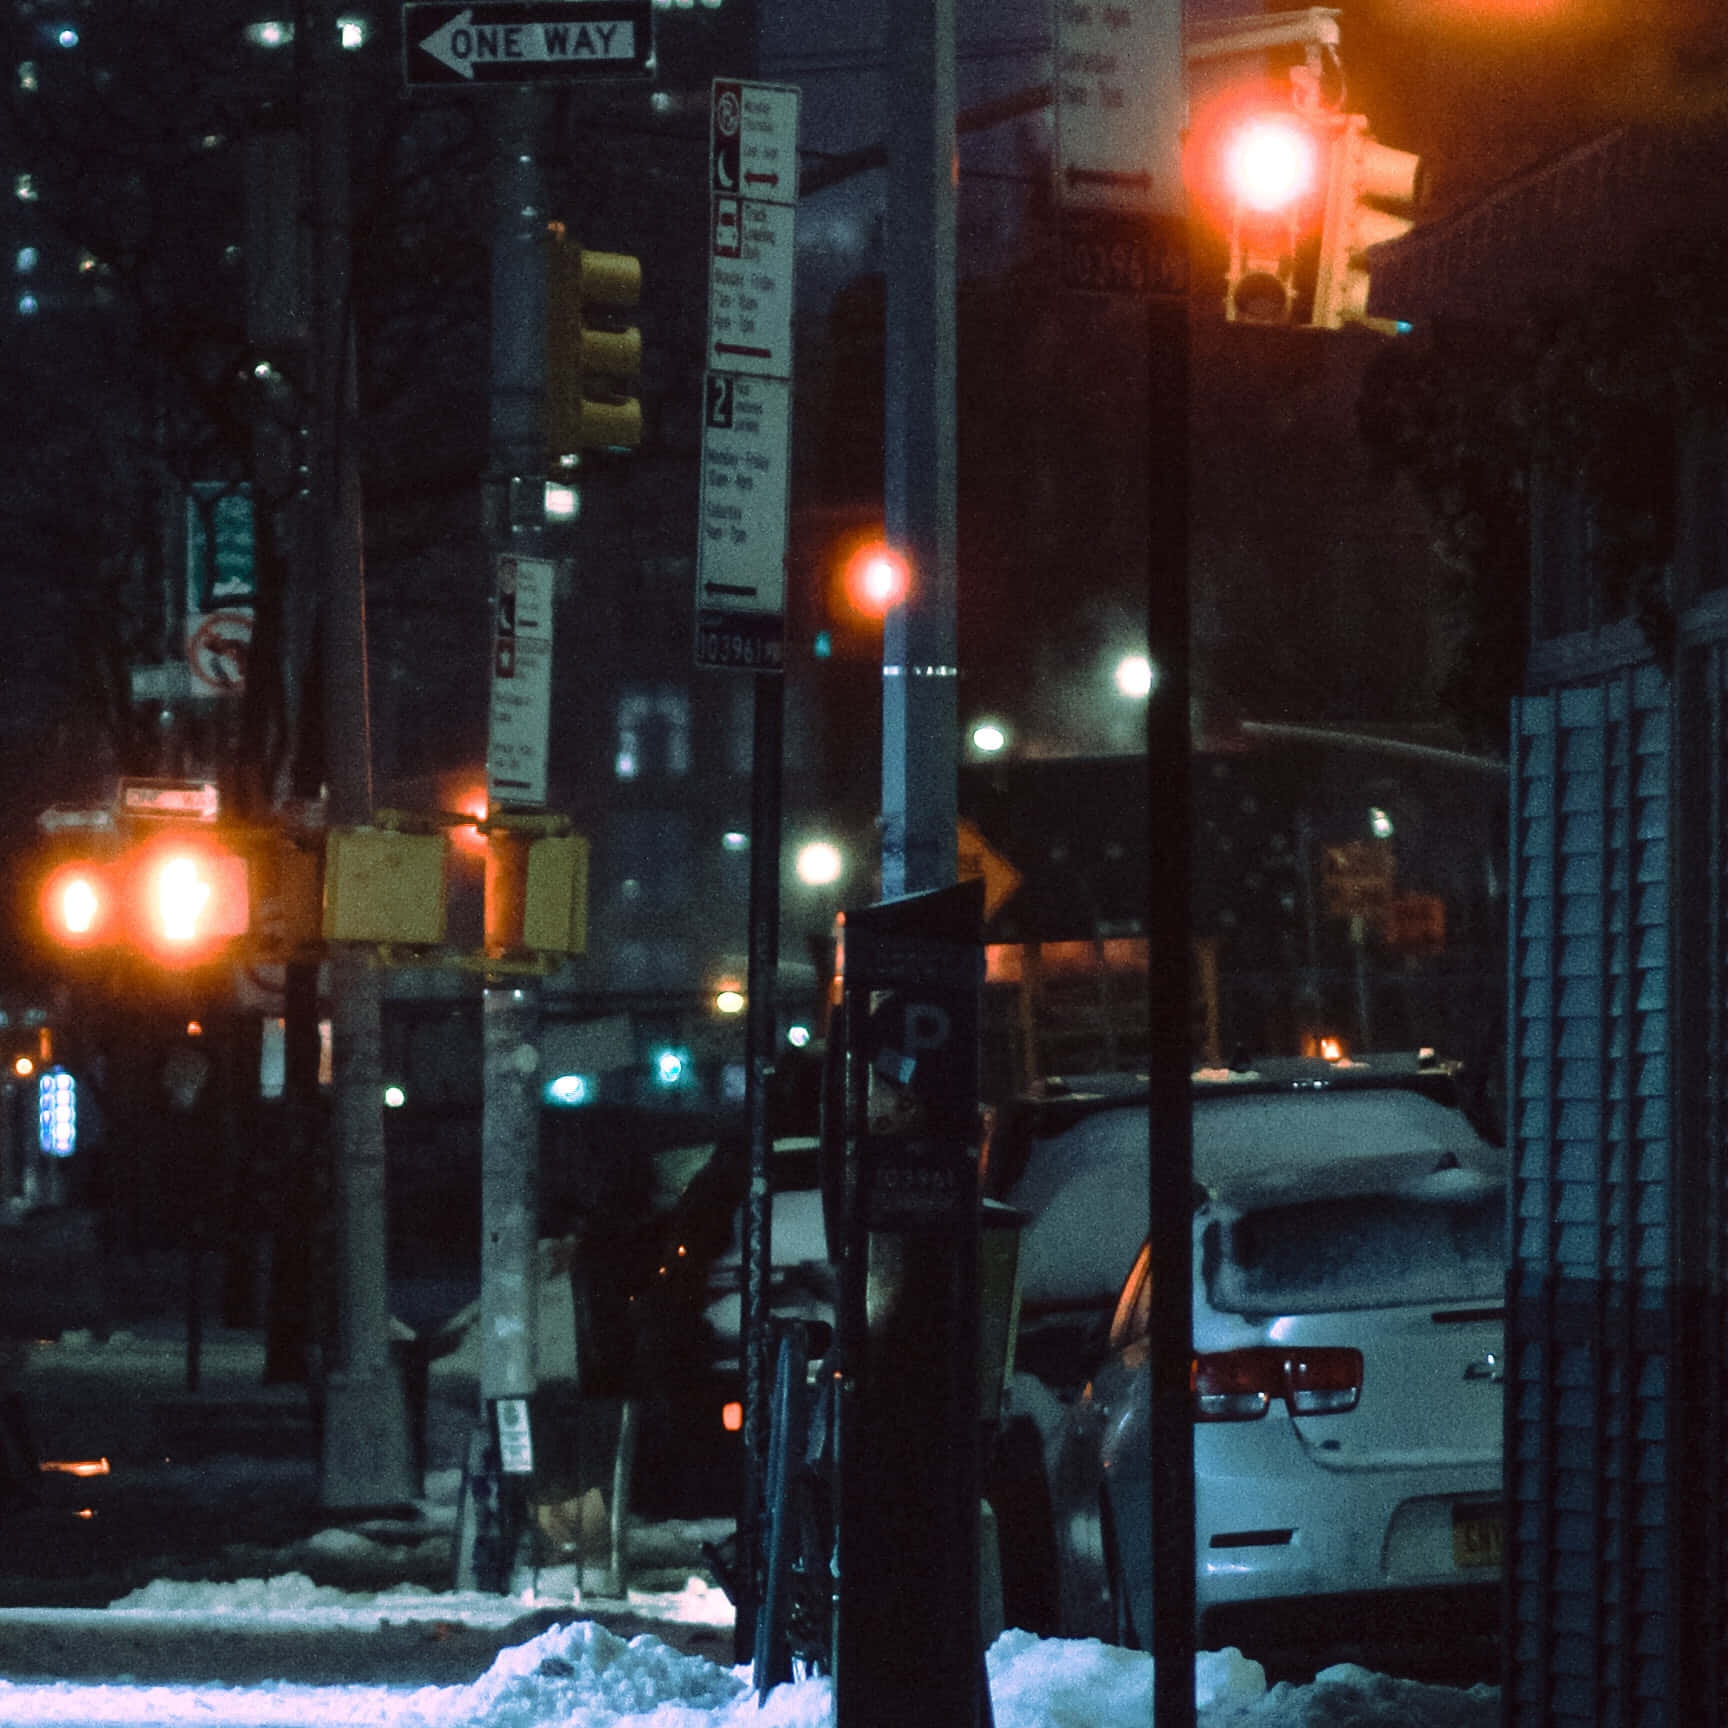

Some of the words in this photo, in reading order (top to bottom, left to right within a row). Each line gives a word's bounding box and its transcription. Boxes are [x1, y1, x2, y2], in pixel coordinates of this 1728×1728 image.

[451, 29, 523, 59] ONE
[544, 24, 618, 56] WAY
[712, 376, 726, 423] 2
